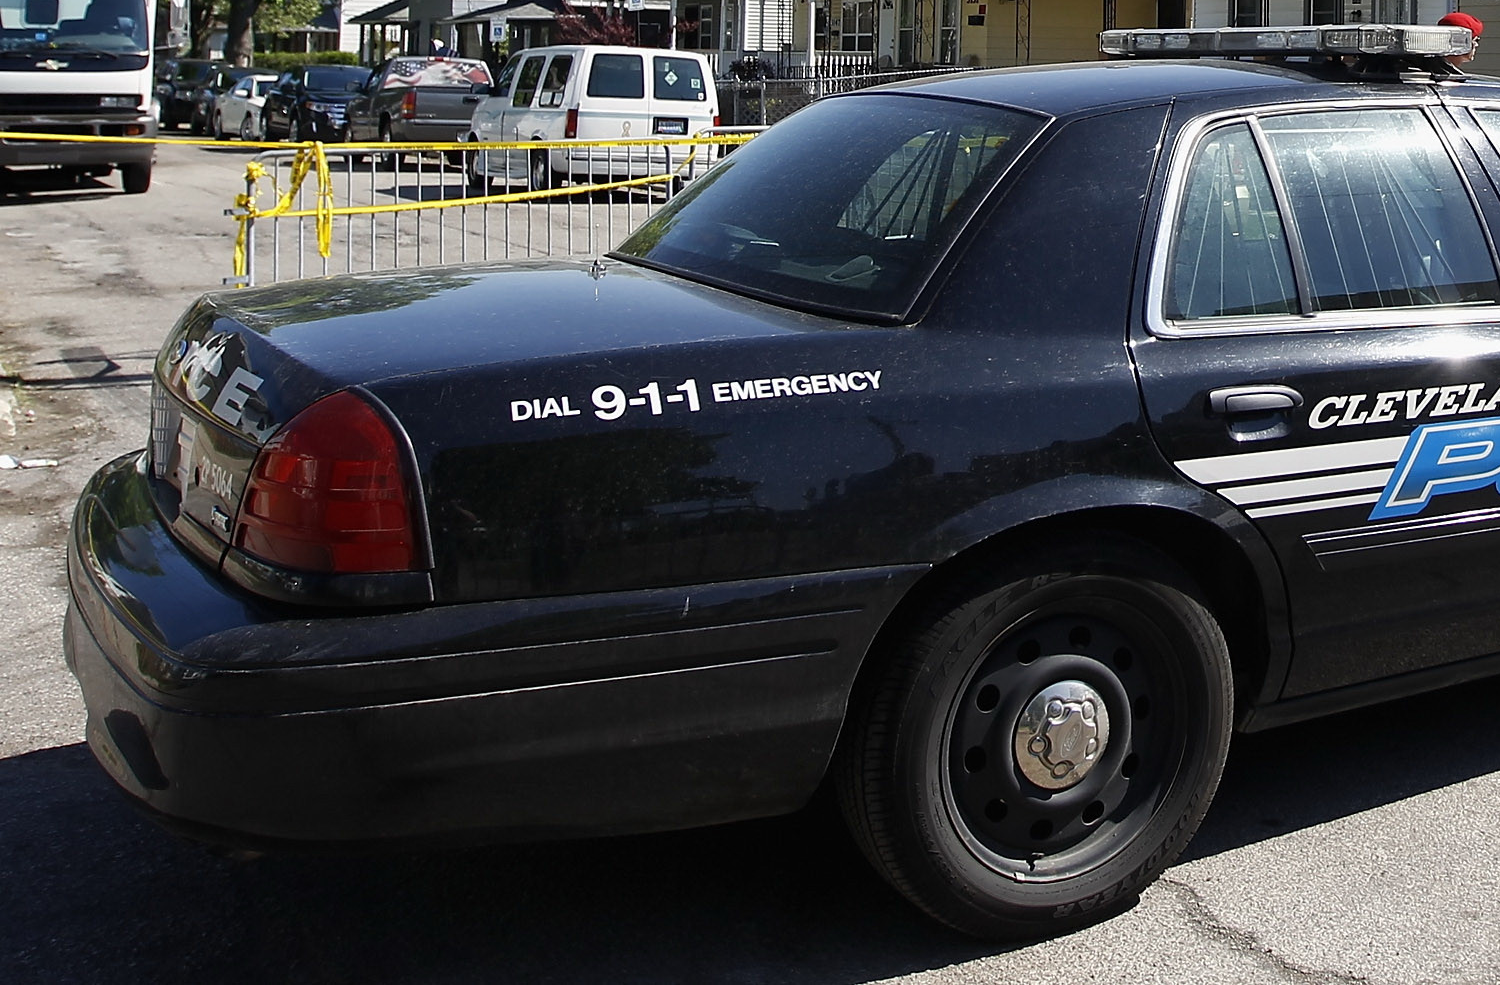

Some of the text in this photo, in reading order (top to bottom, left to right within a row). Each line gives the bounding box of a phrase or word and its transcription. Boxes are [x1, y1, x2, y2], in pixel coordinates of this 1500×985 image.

[510, 370, 883, 422] DIAL 9-1-1 EMERGENCY
[211, 463, 233, 501] 5064
